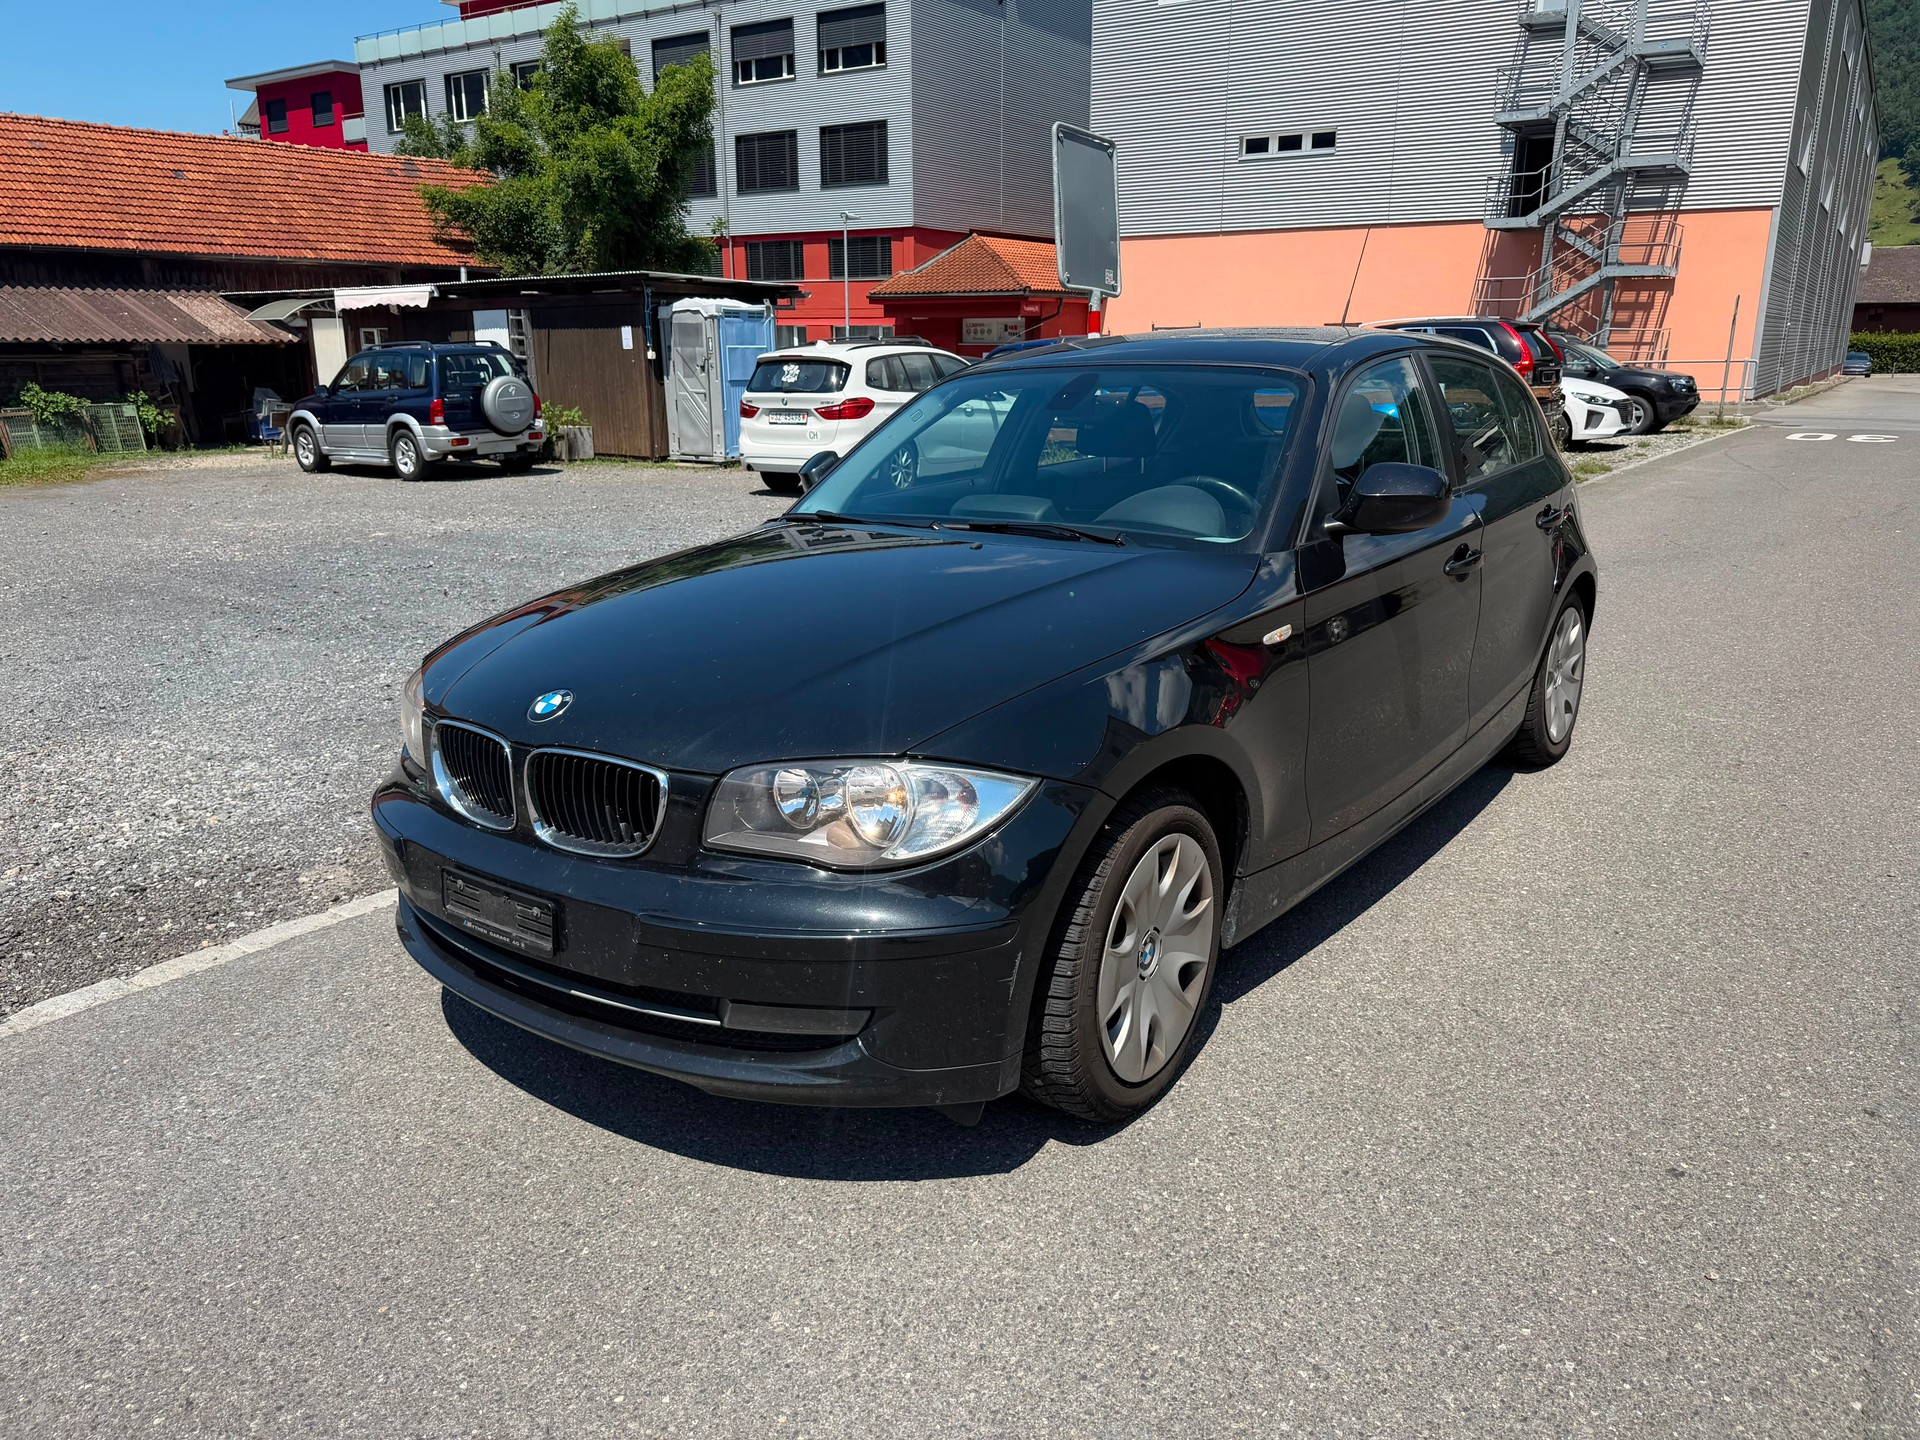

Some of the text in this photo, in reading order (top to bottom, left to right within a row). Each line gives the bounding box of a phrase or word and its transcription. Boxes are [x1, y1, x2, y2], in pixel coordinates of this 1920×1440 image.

[808, 431, 818, 440] CH
[1785, 432, 1899, 443] 30
[489, 931, 511, 943] GARAGE
